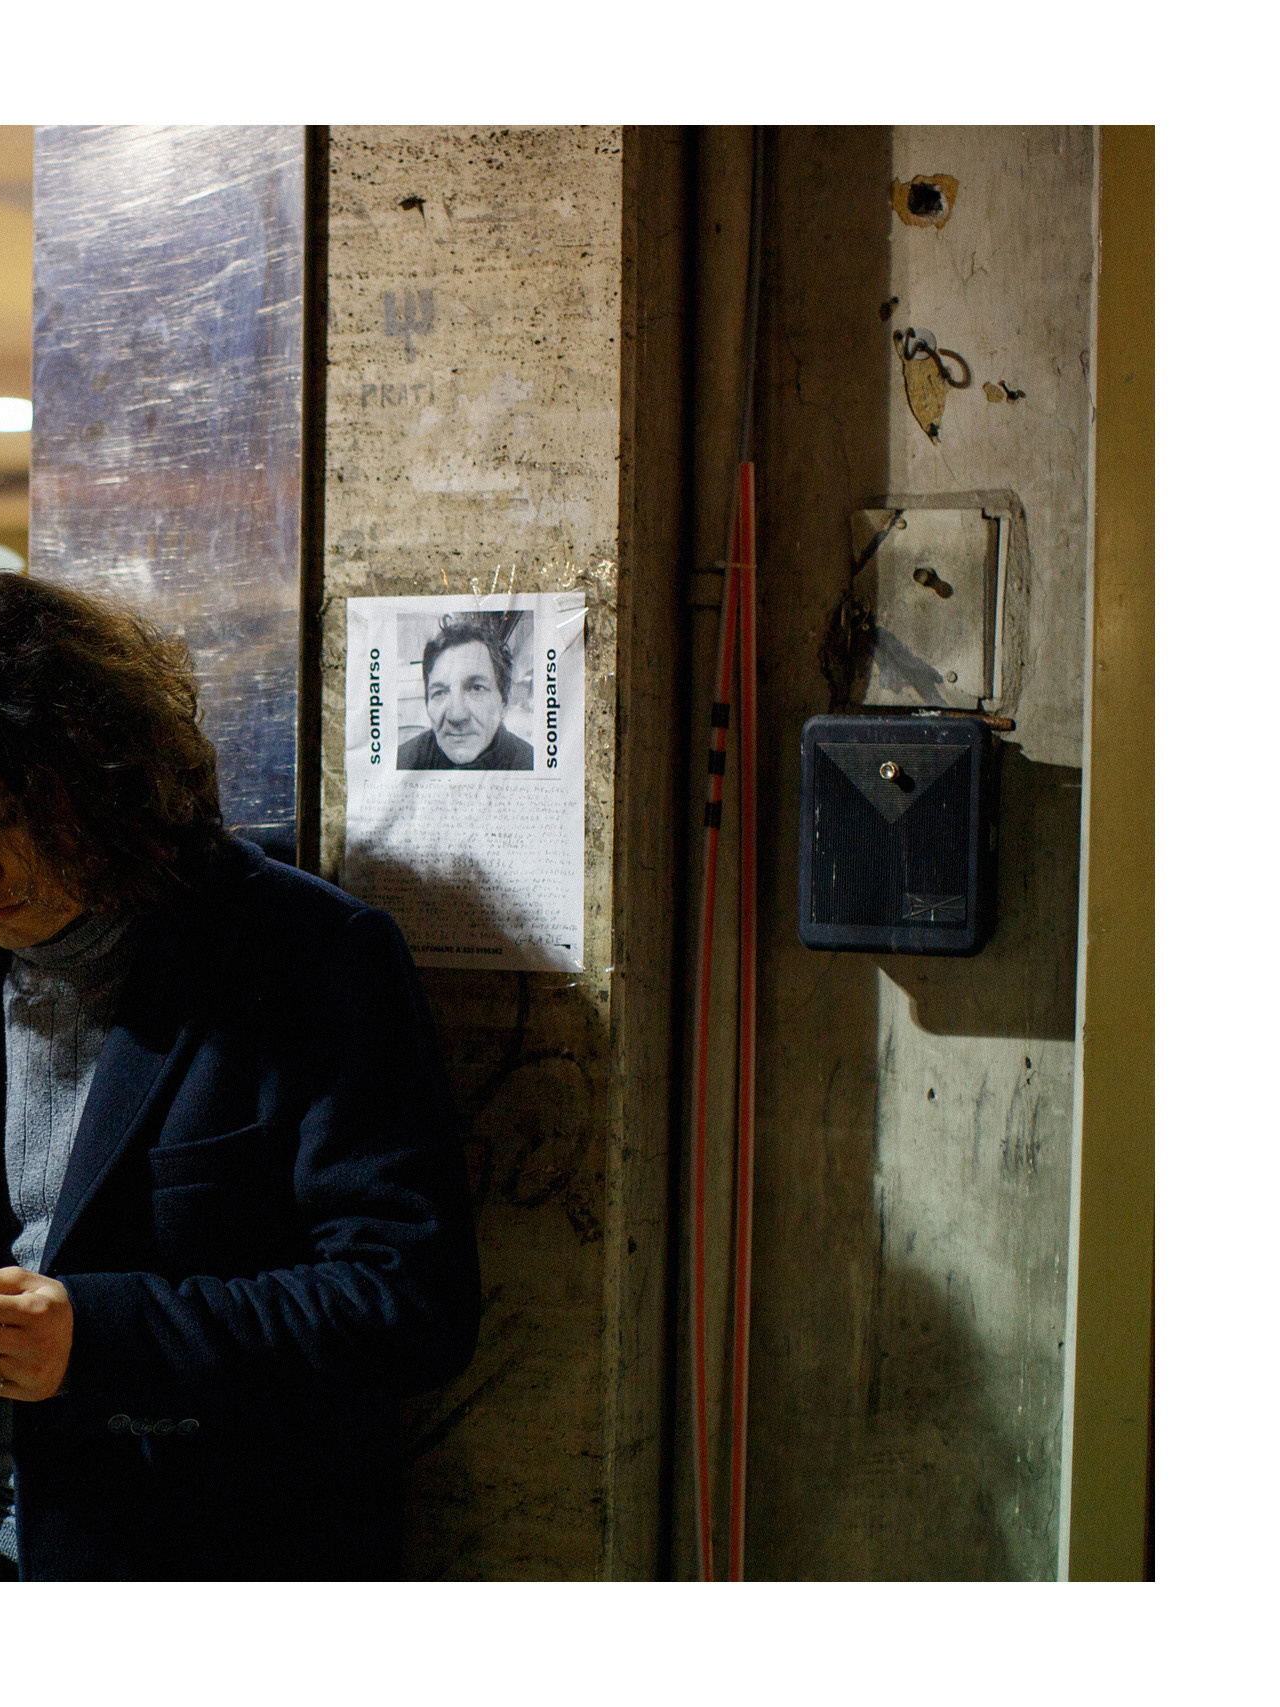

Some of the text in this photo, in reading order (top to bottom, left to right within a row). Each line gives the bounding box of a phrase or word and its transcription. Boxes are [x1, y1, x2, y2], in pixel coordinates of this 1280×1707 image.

[370, 648, 383, 765] scomparso
[546, 649, 561, 769] scomparso
[515, 933, 562, 946] GRAZIE
